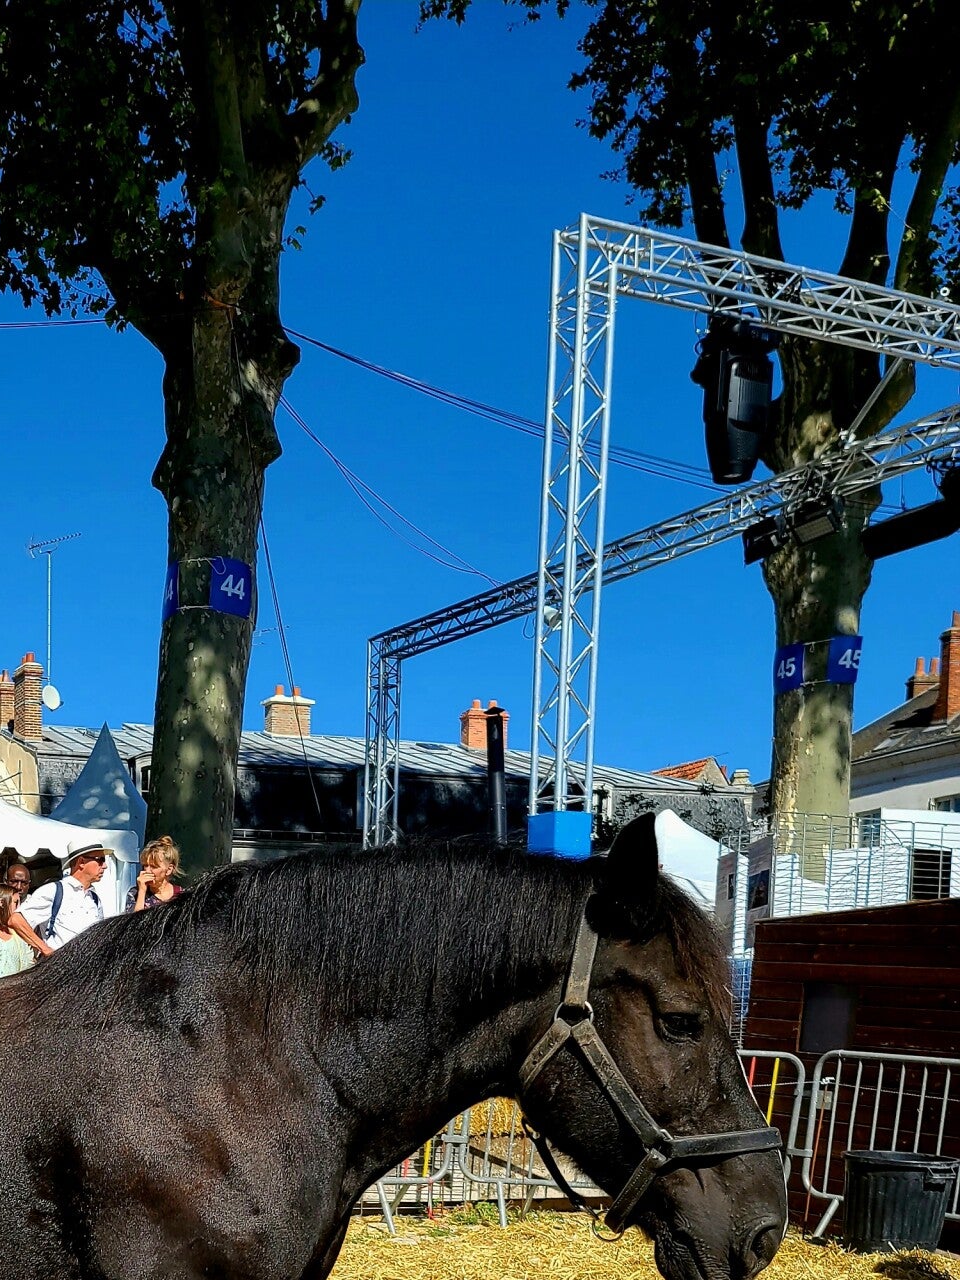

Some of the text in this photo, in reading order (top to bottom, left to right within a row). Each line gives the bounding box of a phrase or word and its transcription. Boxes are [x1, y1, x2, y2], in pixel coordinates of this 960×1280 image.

[220, 574, 245, 600] 44
[777, 657, 796, 679] 45
[838, 648, 862, 669] 45
